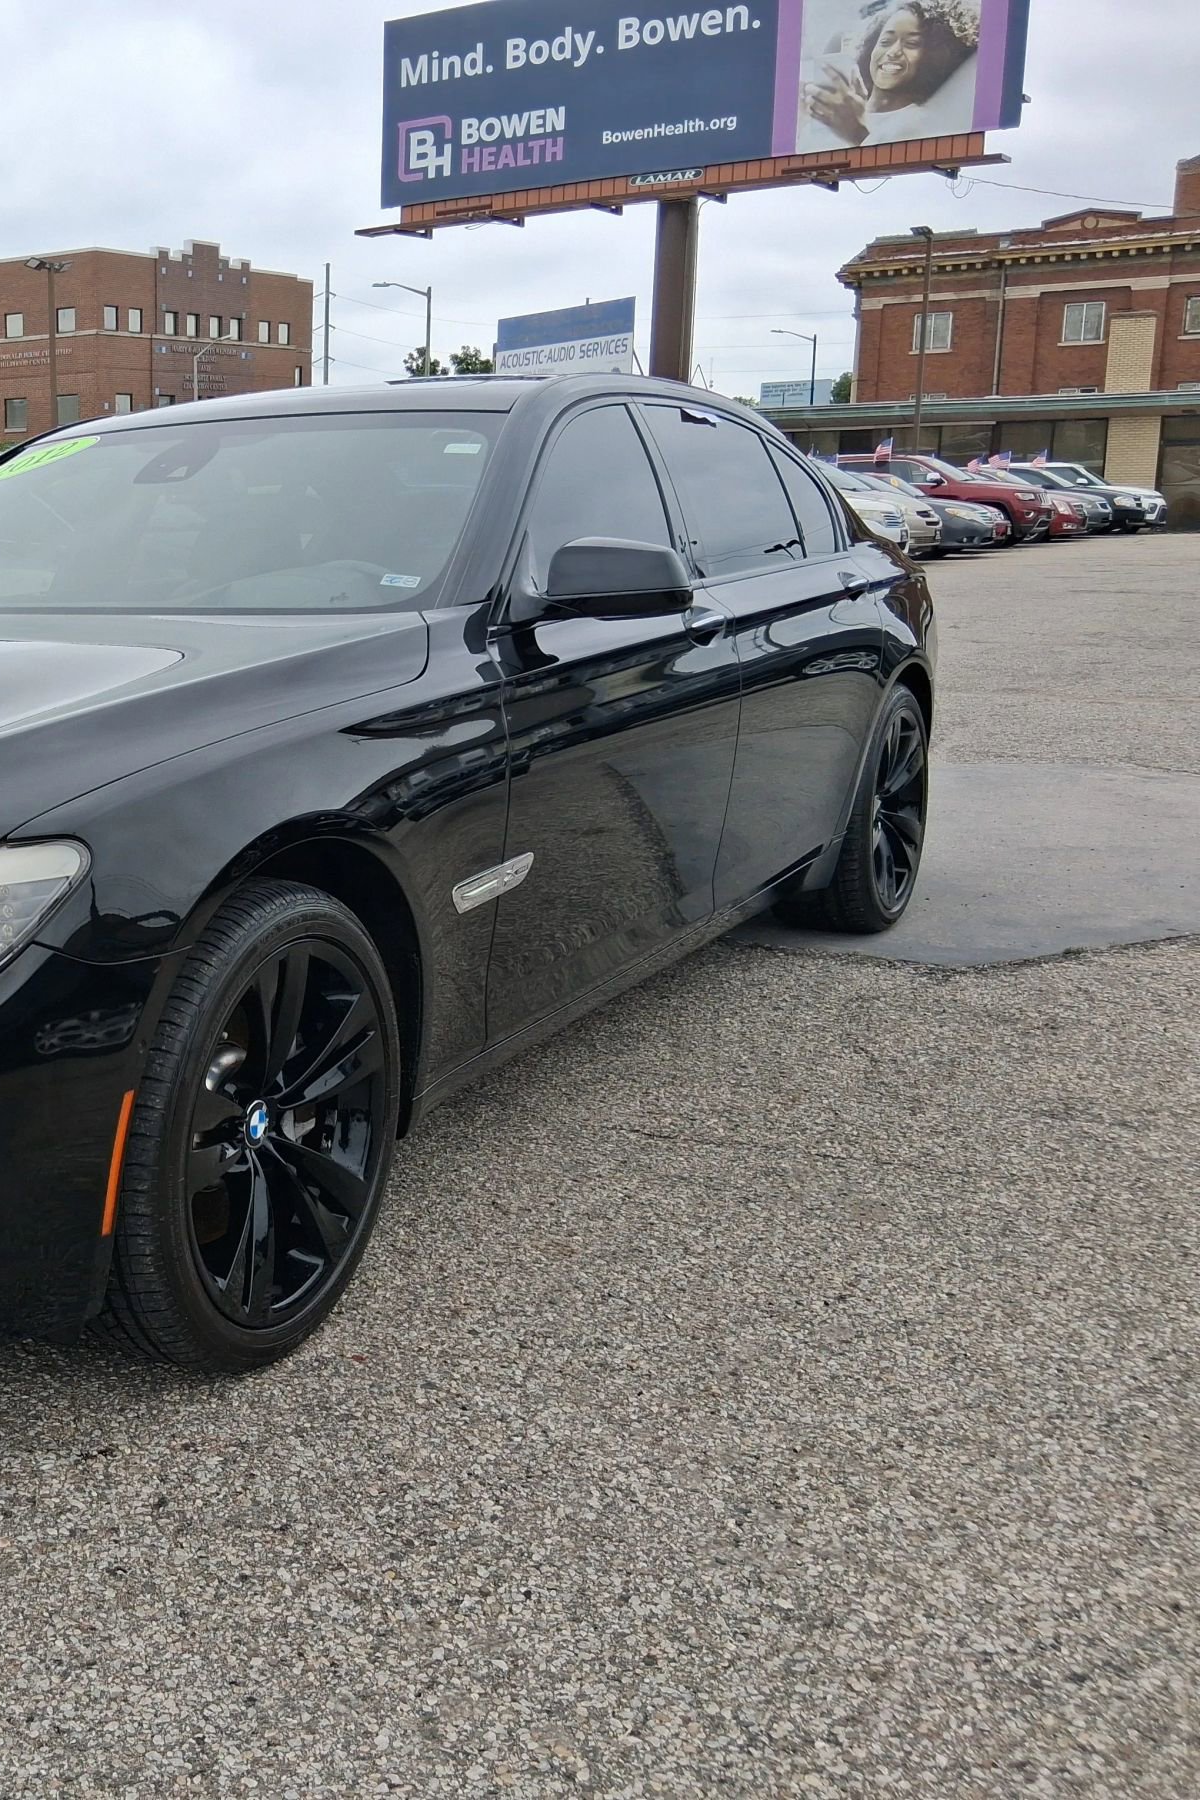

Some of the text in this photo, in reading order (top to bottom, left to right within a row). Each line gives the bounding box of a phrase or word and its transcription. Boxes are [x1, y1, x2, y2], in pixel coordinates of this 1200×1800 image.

[400, 4, 761, 88] Mind. Body. Bowen.
[460, 105, 566, 146] BOWEN
[602, 115, 738, 145] BowenHealth.org
[460, 136, 564, 175] HEALTH
[635, 170, 696, 186] LAMAR
[499, 337, 629, 370] ACOUSTIC-AUDIO SERVICES
